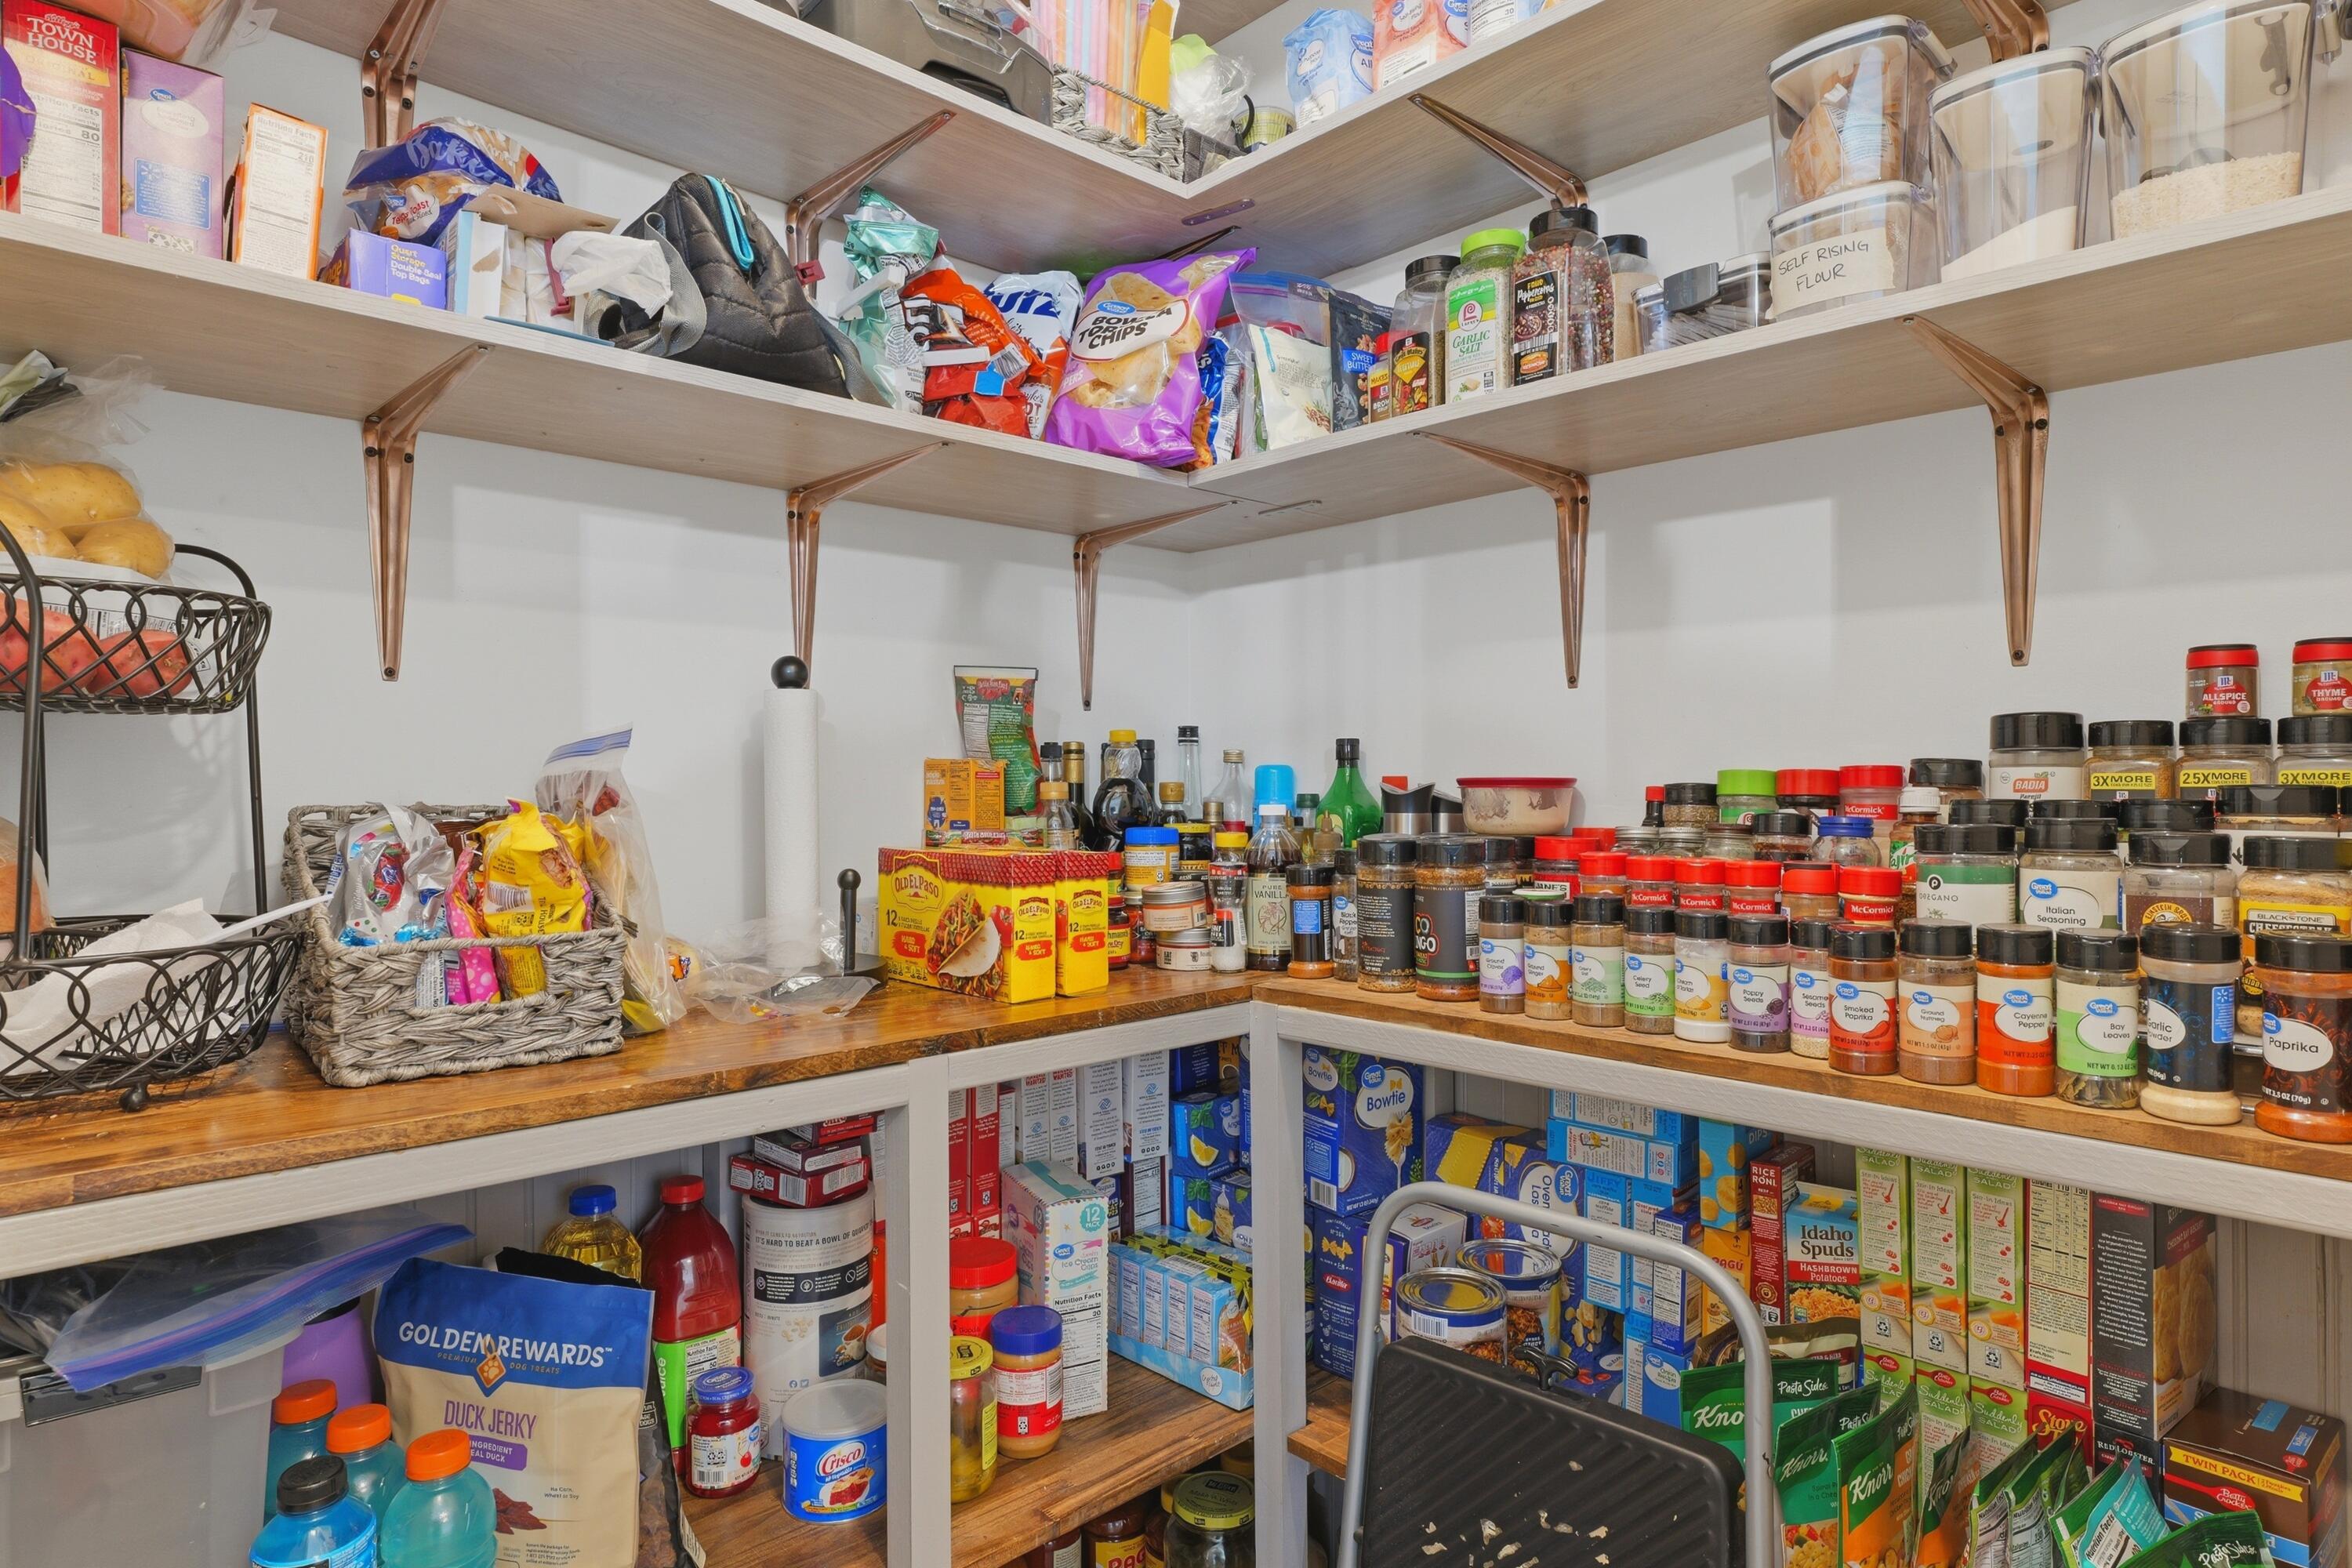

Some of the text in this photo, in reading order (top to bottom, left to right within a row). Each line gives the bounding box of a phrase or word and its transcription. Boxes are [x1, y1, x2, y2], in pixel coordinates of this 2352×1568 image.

[27, 16, 94, 49] TOWN
[27, 31, 96, 65] HOUSE
[81, 129, 100, 142] 80
[391, 244, 418, 257] Quart
[1778, 241, 1868, 275] SELF RISING
[391, 267, 430, 285] Top Bags
[1796, 263, 1846, 292] FLOUR
[1088, 321, 1148, 350] CHIPS
[1453, 329, 1490, 348] GARLIC
[1459, 342, 1483, 358] SALT
[1352, 352, 1373, 364] SWEET
[2202, 692, 2246, 701] ALLSPICE
[2015, 780, 2045, 789] BADIA
[2092, 775, 2109, 787] 3X
[2182, 772, 2211, 784] 2.5X
[2281, 773, 2302, 785] 3X
[895, 873, 939, 898] OLD EL PASO
[1732, 902, 1772, 911] McCormick
[2045, 906, 2075, 915] Italian
[885, 909, 898, 927] 12
[2037, 914, 2086, 926] Seasoning
[2256, 913, 2325, 924] BLACKSTONE
[1069, 922, 1080, 932] 12
[1014, 930, 1025, 940] 12
[1633, 975, 1653, 984] Celery
[1743, 989, 1764, 997] Poppy
[1802, 992, 1829, 1001] Sesame
[1805, 1000, 1826, 1009] Seeds
[1843, 1004, 1875, 1014] Smoked
[1845, 1012, 1874, 1022] Paprika
[1921, 1008, 1945, 1017] Ground
[2013, 1011, 2049, 1021] Cayenne
[2018, 1020, 2045, 1029] Pepper
[2110, 1022, 2125, 1033] Bay
[2268, 1036, 2320, 1054] Paprika
[1308, 1066, 1333, 1083] Bowtie
[1364, 1071, 1382, 1081] Great
[1367, 1090, 1406, 1112] Bowtie
[1749, 1129, 1769, 1145] DIPS
[1861, 1156, 1898, 1167] SALAD
[1751, 1166, 1777, 1178] RICE
[1916, 1165, 1954, 1178] SALAD
[1564, 1169, 1573, 1197] Great
[1751, 1176, 1777, 1186] RONI
[1974, 1177, 2011, 1190] SALAD
[1085, 1207, 1101, 1222] 12
[1801, 1224, 1853, 1241] Idaho
[766, 1239, 783, 1247] HARD
[796, 1239, 814, 1247] BEAT
[822, 1234, 841, 1245] BOWL
[843, 1232, 851, 1240] OF
[1801, 1240, 1855, 1261] Spuds
[1075, 1256, 1100, 1267] Cream
[1800, 1262, 1857, 1275] HASHBROWN
[1810, 1272, 1847, 1283] Potatoes
[1054, 1291, 1102, 1307] Nutrition Facts
[398, 1321, 492, 1356] GOLDEN
[437, 1352, 477, 1365] PREMIUM
[509, 1363, 561, 1375] DOG TREATS
[1777, 1381, 1803, 1396] Pasta
[1919, 1384, 1966, 1412] Suddenly
[1923, 1399, 1962, 1416] SALAD
[444, 1399, 538, 1440] DUCK JERKY
[1973, 1402, 2023, 1431] Suddenly
[1976, 1416, 2018, 1434] SALAD
[2096, 1439, 2116, 1452] RED
[486, 1452, 506, 1463] DUCK
[822, 1448, 861, 1475] Crisco
[1780, 1448, 1829, 1483] Knorr
[2183, 1454, 2256, 1484] TWIN PACK
[1849, 1462, 1894, 1505] Knorr
[2222, 1488, 2246, 1501] Betty
[2216, 1494, 2252, 1510] Crocker
[2085, 1512, 2116, 1561] Nutrition Facts
